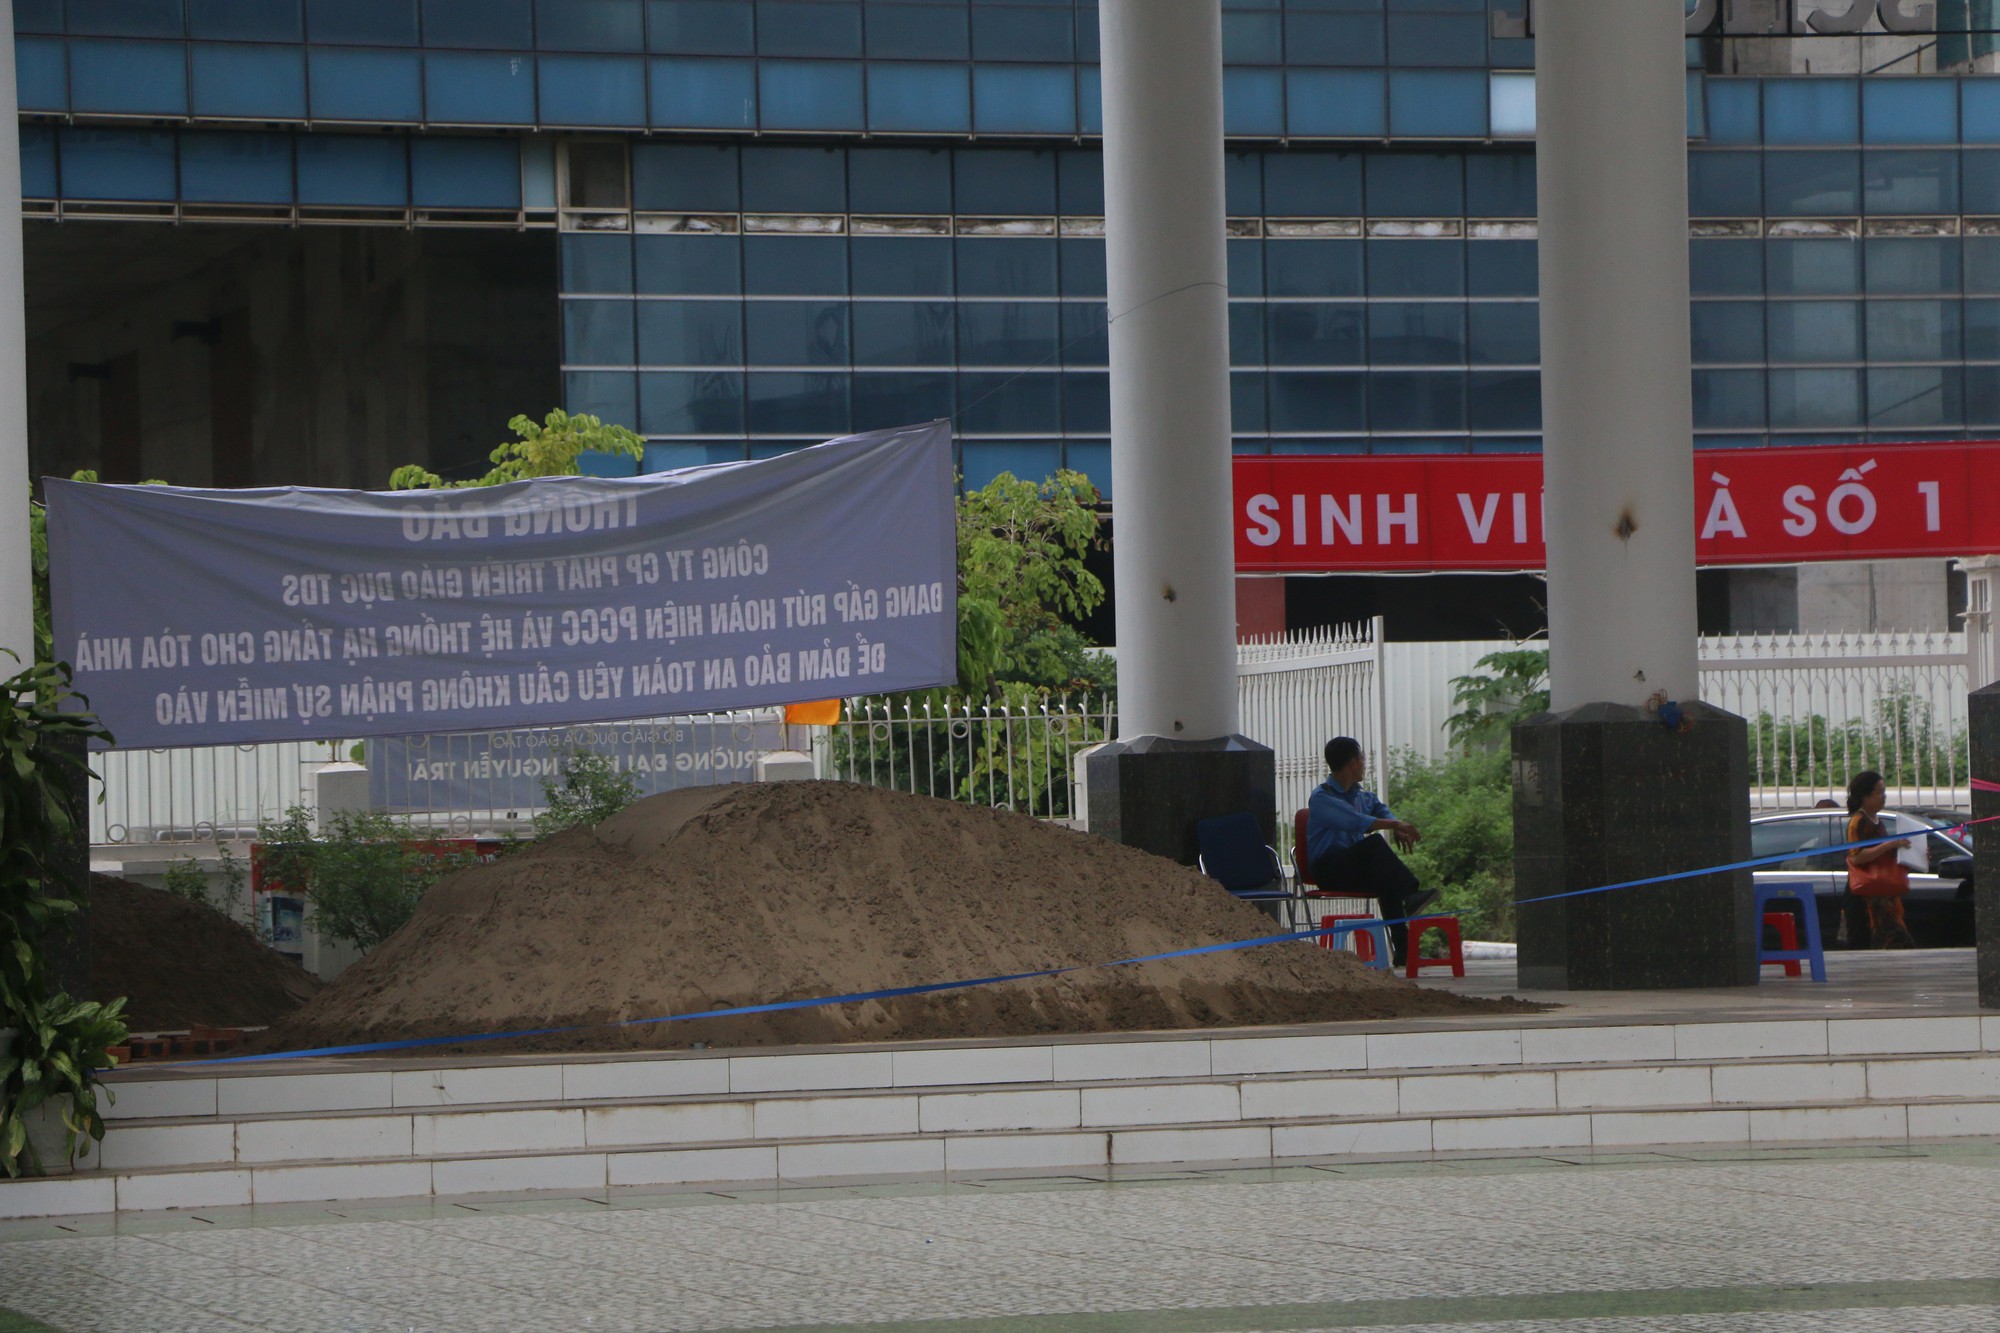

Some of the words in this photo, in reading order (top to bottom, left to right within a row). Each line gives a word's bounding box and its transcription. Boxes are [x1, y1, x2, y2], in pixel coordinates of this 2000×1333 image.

[1245, 492, 1418, 547] SINH
[1456, 485, 1545, 545] VI
[1699, 471, 1747, 540] À
[1781, 458, 1877, 537] SỐ
[1917, 480, 1941, 532] 1
